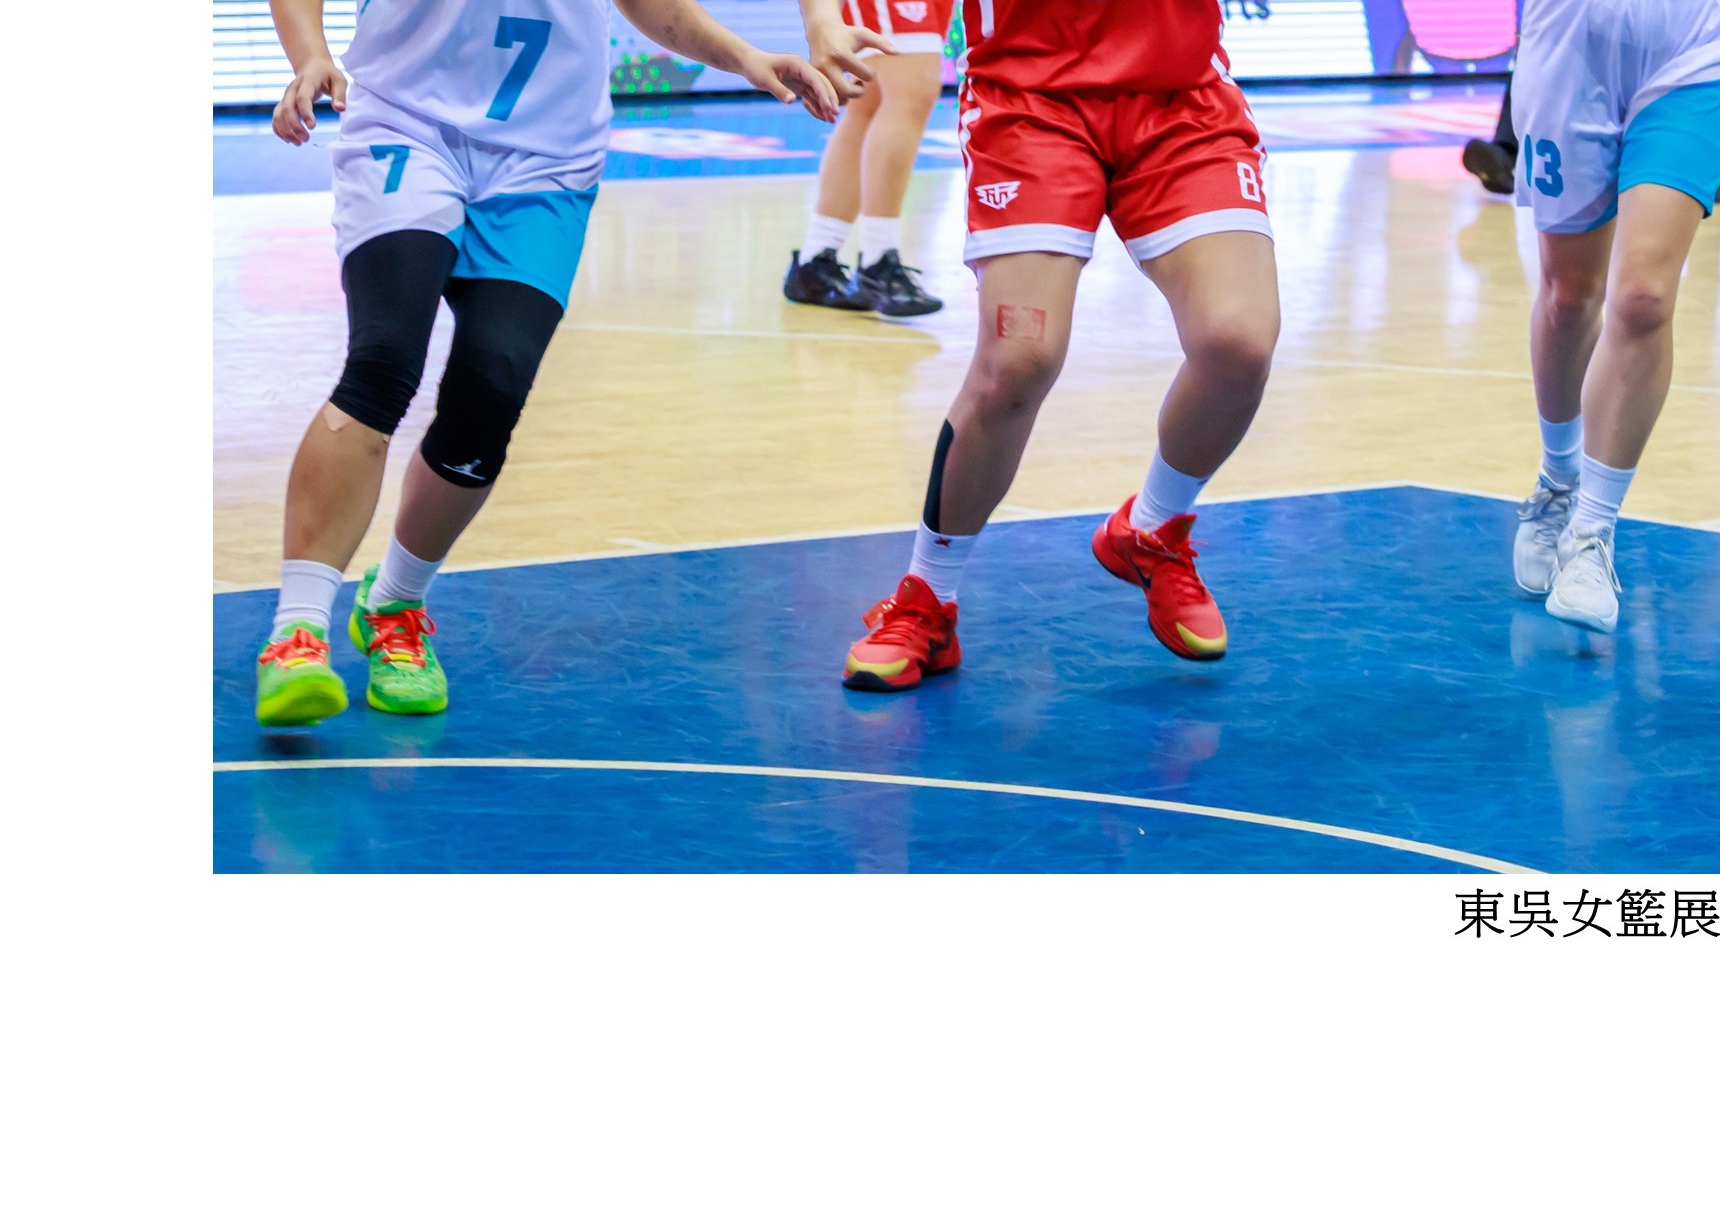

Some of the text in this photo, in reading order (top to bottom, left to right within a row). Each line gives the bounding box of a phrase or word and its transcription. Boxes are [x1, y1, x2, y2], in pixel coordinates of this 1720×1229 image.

[486, 15, 552, 122] 7
[369, 144, 410, 194] 7
[1236, 161, 1261, 203] 8
